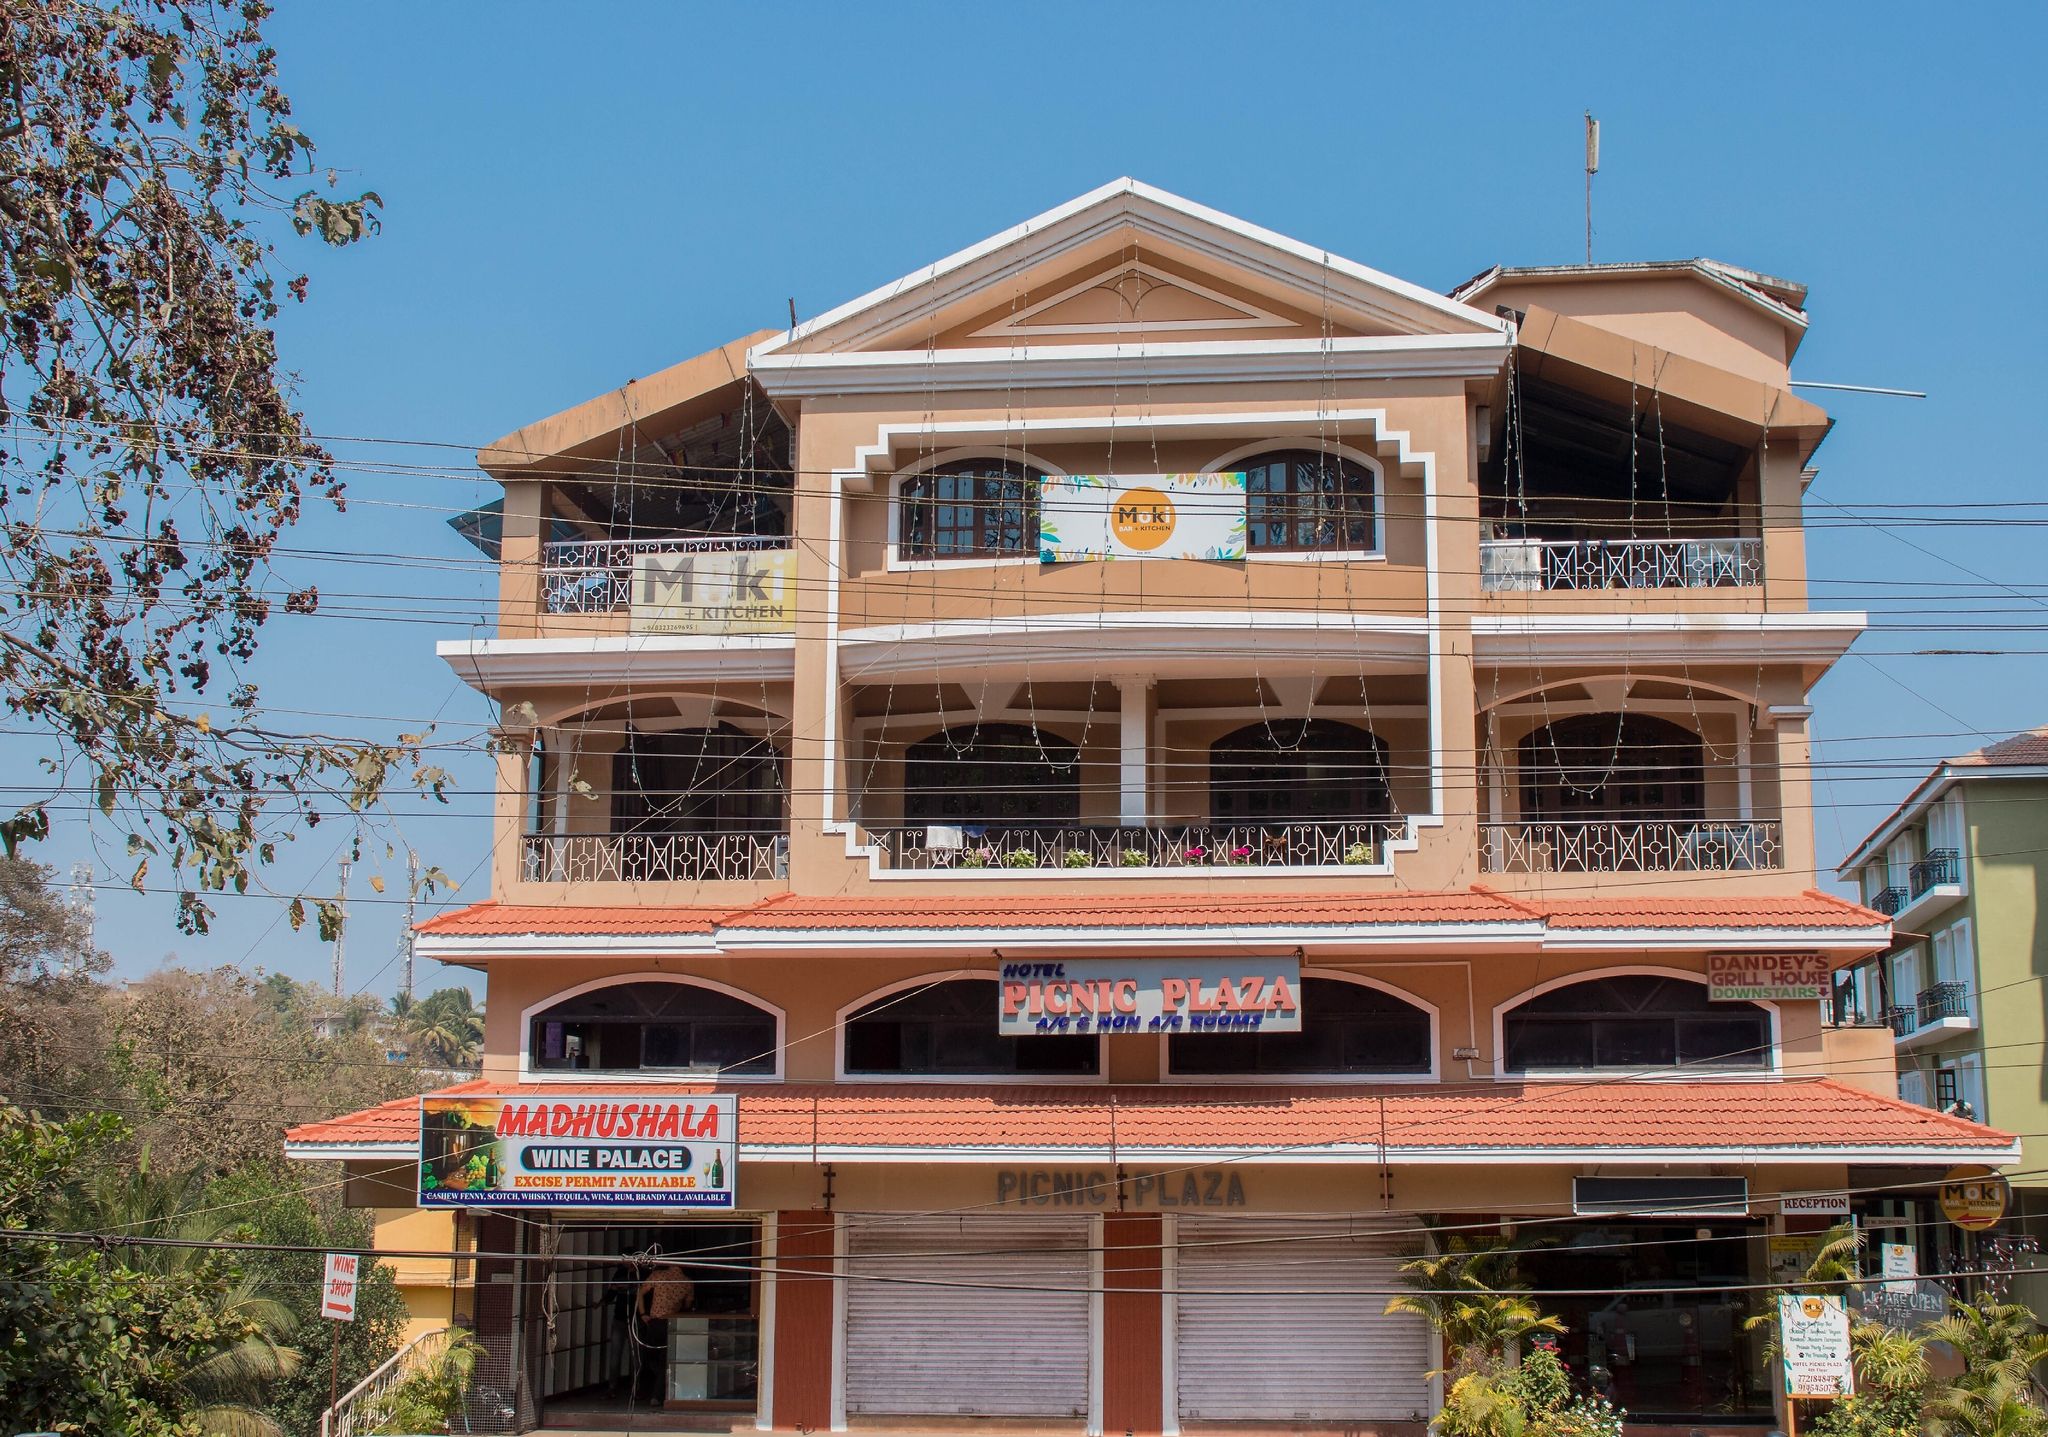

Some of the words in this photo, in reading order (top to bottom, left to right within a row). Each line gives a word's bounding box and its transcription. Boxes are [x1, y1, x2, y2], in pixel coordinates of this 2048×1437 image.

[1119, 506, 1170, 524] Moki
[702, 605, 783, 619] KITCHEN
[1003, 963, 1065, 977] HOTEL
[1710, 955, 1829, 971] DANDEY'S
[1711, 971, 1764, 986] GRILL
[1770, 971, 1829, 985] HOUSE
[1002, 978, 1137, 1014] PICNIC
[1161, 976, 1297, 1012] PLAZA
[1712, 987, 1817, 998] DOWNSTAIRS
[1036, 1016, 1070, 1030] A/C
[1097, 1015, 1142, 1029] NON
[1148, 1014, 1183, 1029] A/C
[1190, 1013, 1264, 1027] ROOMS
[496, 1104, 719, 1138] MADHUSHALA
[532, 1149, 590, 1168] WINE
[597, 1149, 682, 1168] PALACE
[514, 1176, 562, 1187] EXCISE
[565, 1176, 616, 1187] PERMIT
[620, 1176, 696, 1187] AVAILABLE
[998, 1171, 1106, 1206] PICNIC
[1135, 1171, 1246, 1206] PLAZA
[426, 1192, 458, 1200] CASHEW
[636, 1193, 667, 1201] BRANDY
[668, 1193, 684, 1201] ALL
[684, 1193, 726, 1201] AVAILABLE
[1945, 1183, 2000, 1200] Moki
[1784, 1198, 1847, 1209] RECEPTION
[333, 1255, 356, 1275] WINE
[330, 1279, 353, 1298] SHOP
[1910, 1293, 1943, 1310] OPEN
